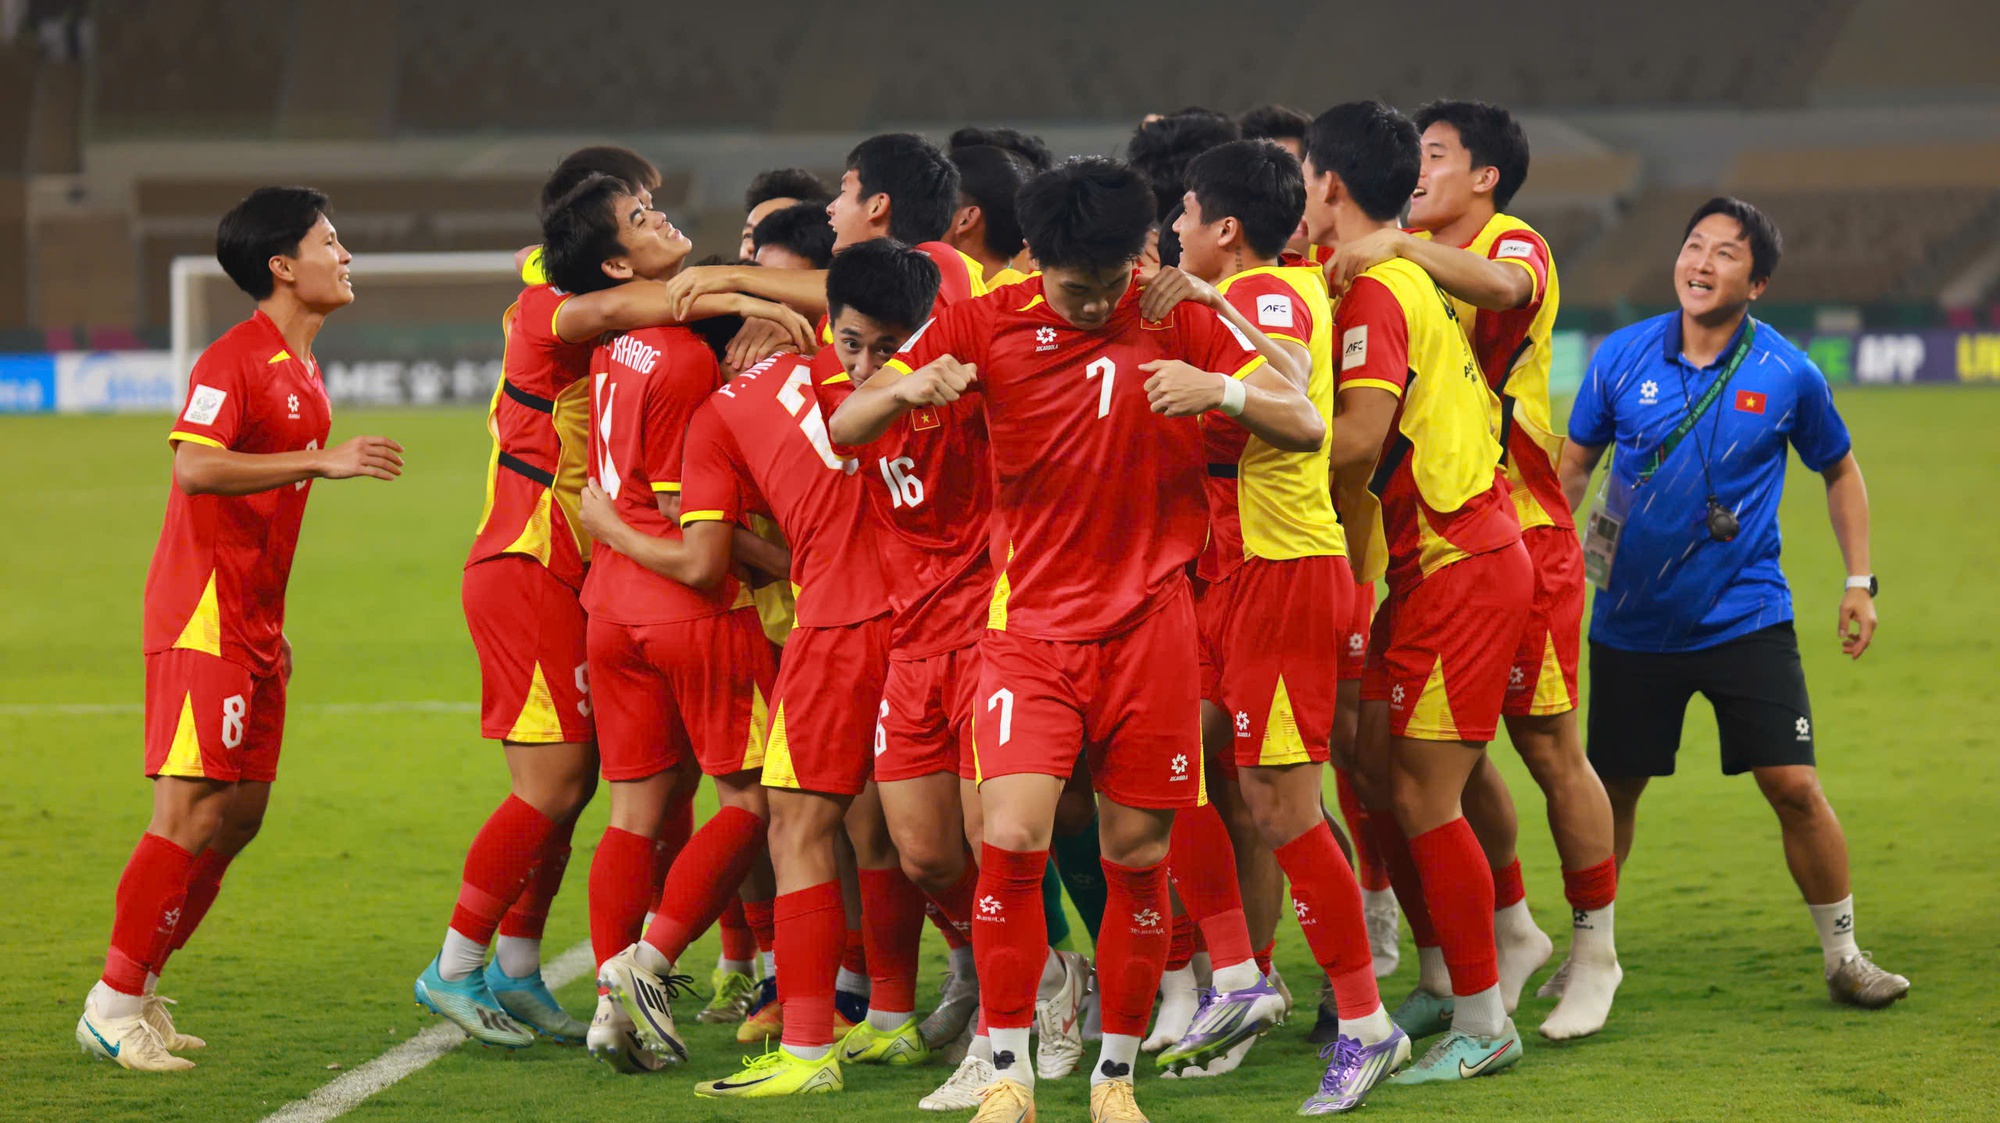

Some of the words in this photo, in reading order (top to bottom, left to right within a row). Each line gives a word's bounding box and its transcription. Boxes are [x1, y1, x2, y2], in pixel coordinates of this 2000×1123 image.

[1262, 304, 1287, 313] AFC
[611, 334, 661, 374] KHANG
[1345, 340, 1363, 354] AFC
[1857, 334, 1926, 385] APP
[1086, 356, 1116, 419] 7
[879, 456, 924, 509] 16
[222, 694, 246, 749] 8
[988, 688, 1014, 747] 7
